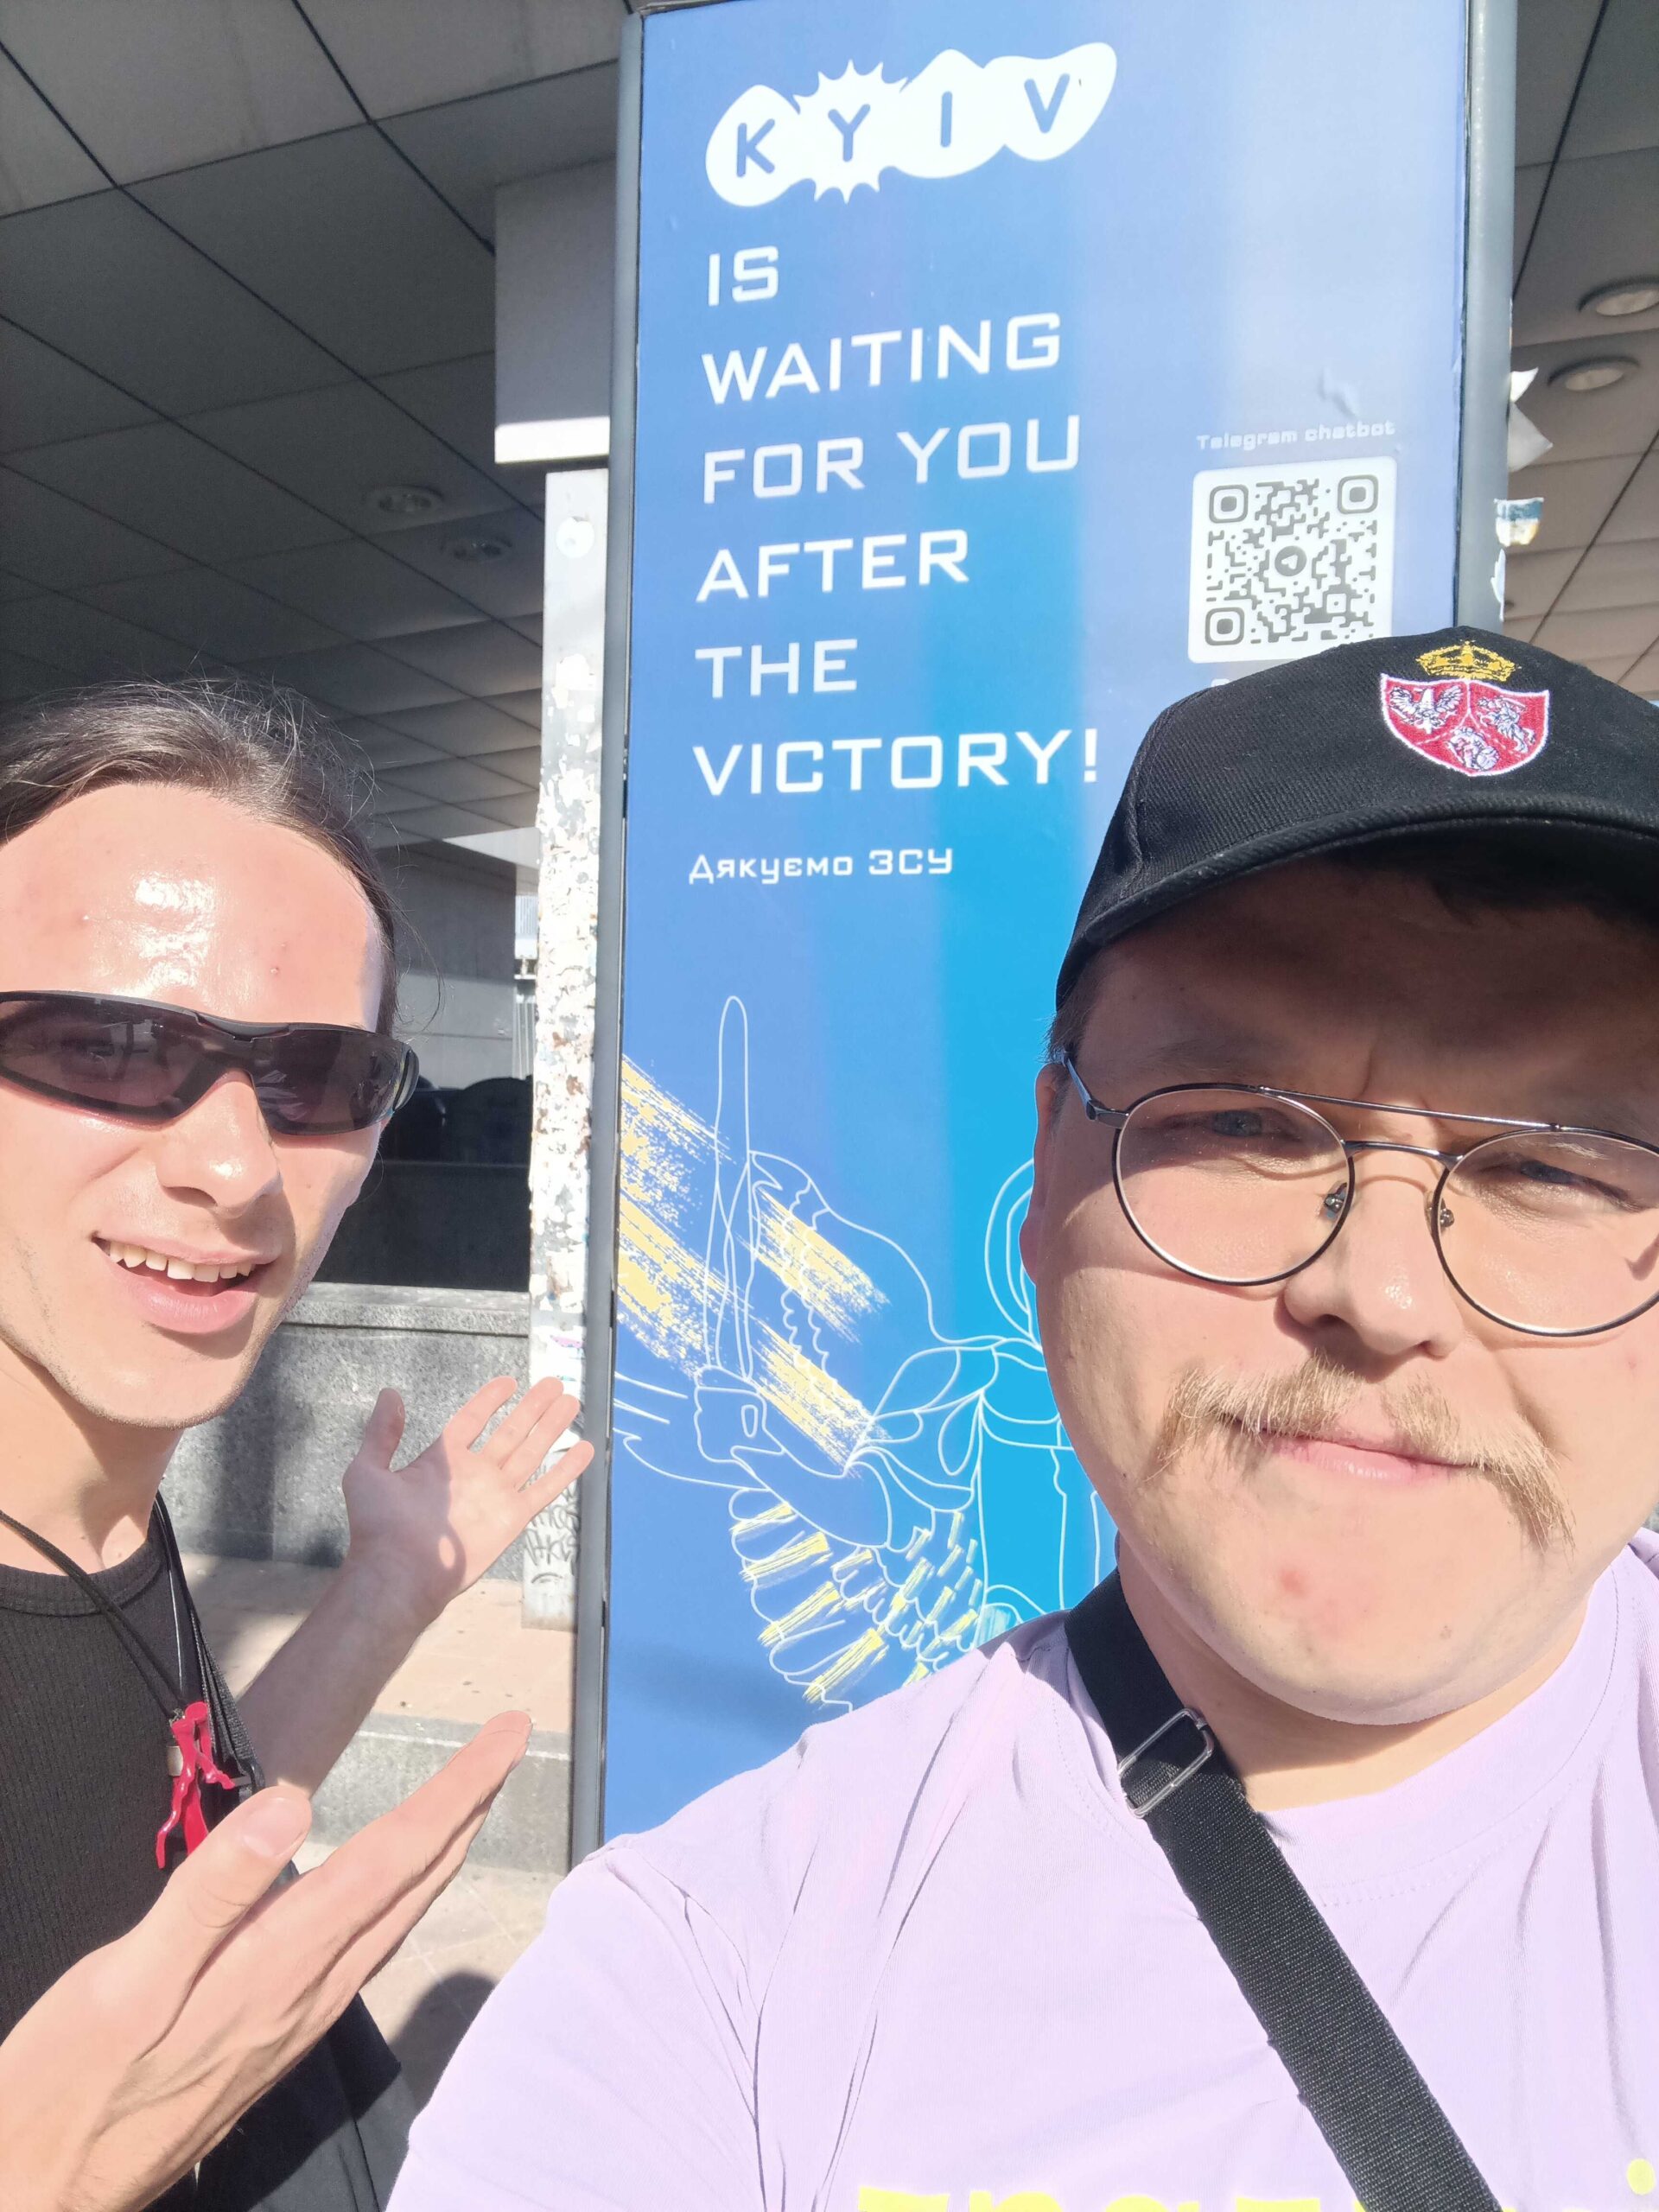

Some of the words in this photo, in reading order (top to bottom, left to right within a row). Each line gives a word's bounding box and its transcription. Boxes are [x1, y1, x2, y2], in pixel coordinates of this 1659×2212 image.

[735, 73, 1071, 178] KYIV
[708, 245, 779, 307] IS
[701, 312, 1061, 405] WAITING
[703, 436, 865, 504] FOR
[896, 414, 1080, 484] YOU
[1197, 430, 1297, 452] Telegram
[1304, 419, 1396, 442] chatbot
[696, 529, 969, 603] AFTER
[695, 639, 858, 698] THE
[692, 728, 1098, 797] VICTORY!
[689, 854, 854, 886] Дякуємо
[868, 848, 953, 876] ЗСУ
